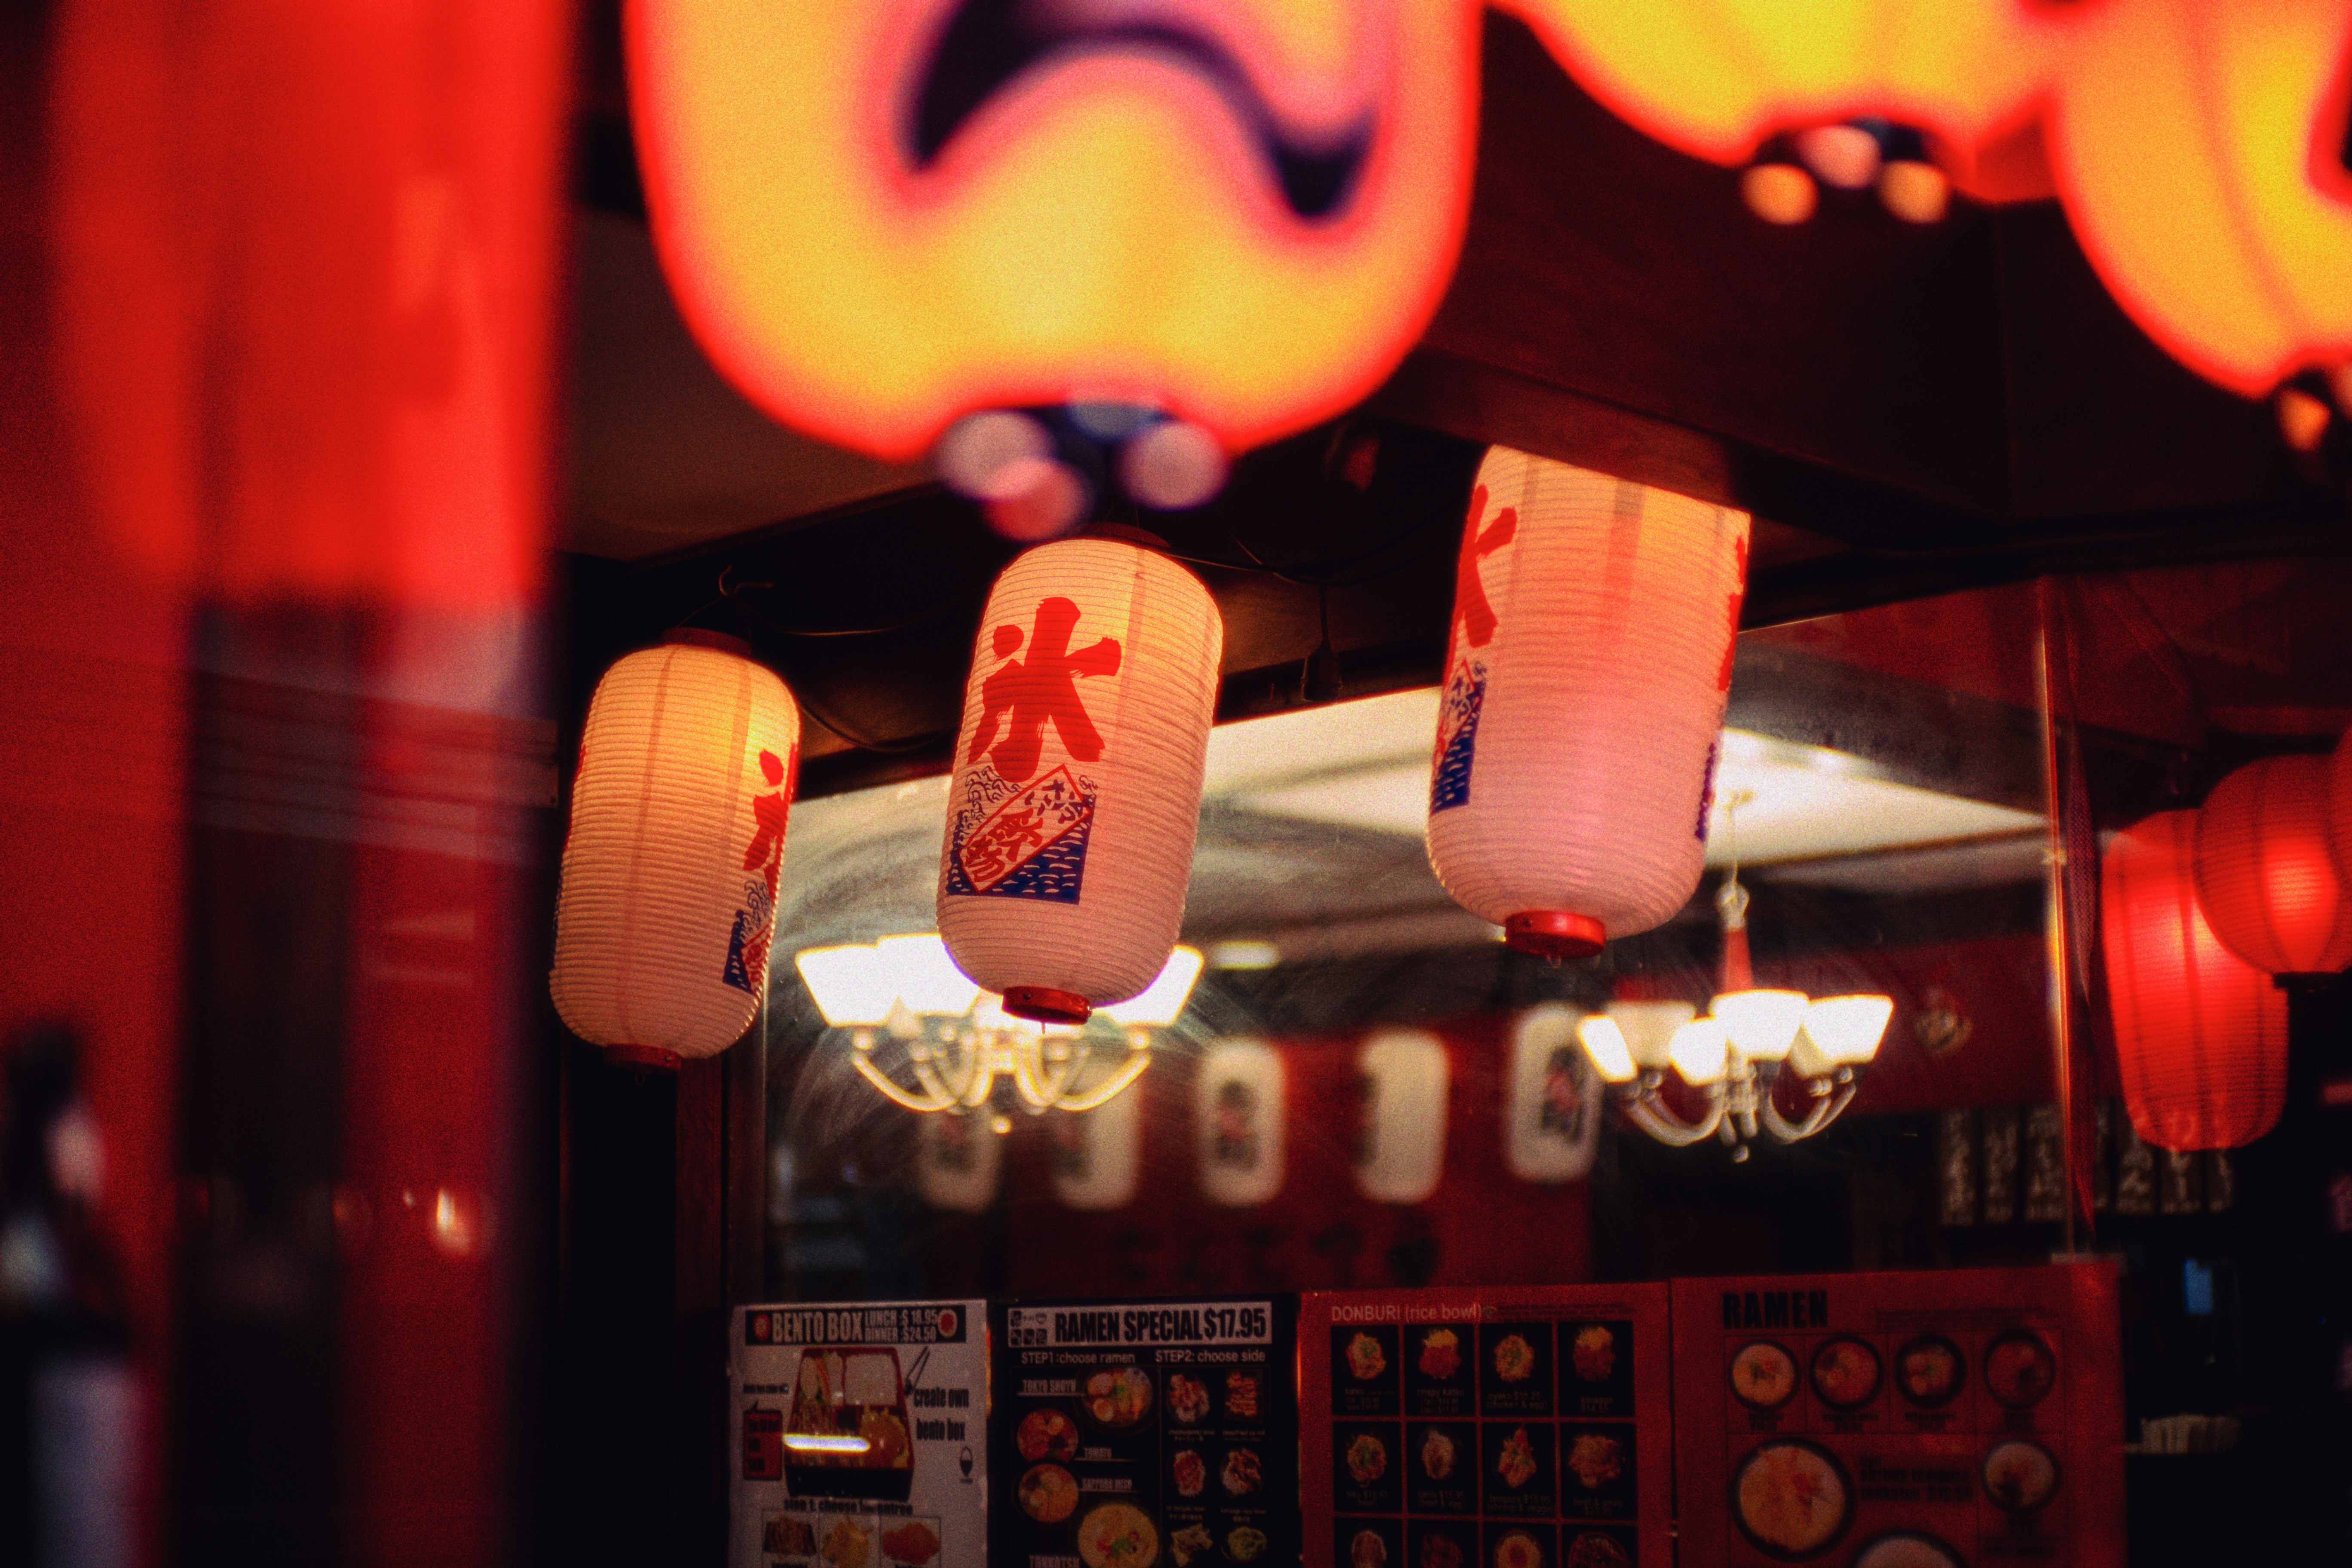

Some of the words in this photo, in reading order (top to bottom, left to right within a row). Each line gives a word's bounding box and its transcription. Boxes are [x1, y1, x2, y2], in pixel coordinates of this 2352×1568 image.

[967, 597, 1122, 783] 氷
[864, 1310, 897, 1327] LUNCH
[1332, 1305, 1401, 1321] DONBURI
[1405, 1304, 1437, 1323] (rice
[1441, 1302, 1482, 1321] bowl)
[1722, 1291, 1828, 1330] RAMEN
[772, 1311, 824, 1343] BENTO
[827, 1311, 863, 1342] BOX
[864, 1327, 898, 1342] DINNER
[1055, 1311, 1120, 1343] RAMEN
[1124, 1309, 1203, 1342] SPECIAL
[1204, 1307, 1266, 1341] $17.95
[1100, 1353, 1135, 1363] ramen
[1155, 1350, 1194, 1363] STEP2:
[1197, 1350, 1238, 1362] choose
[1241, 1349, 1266, 1361] side
[1023, 1380, 1048, 1393] TOKYO
[913, 1388, 945, 1408] create
[948, 1389, 969, 1408] own
[916, 1418, 945, 1440] bento
[947, 1418, 965, 1441] box
[818, 1500, 857, 1513] choose
